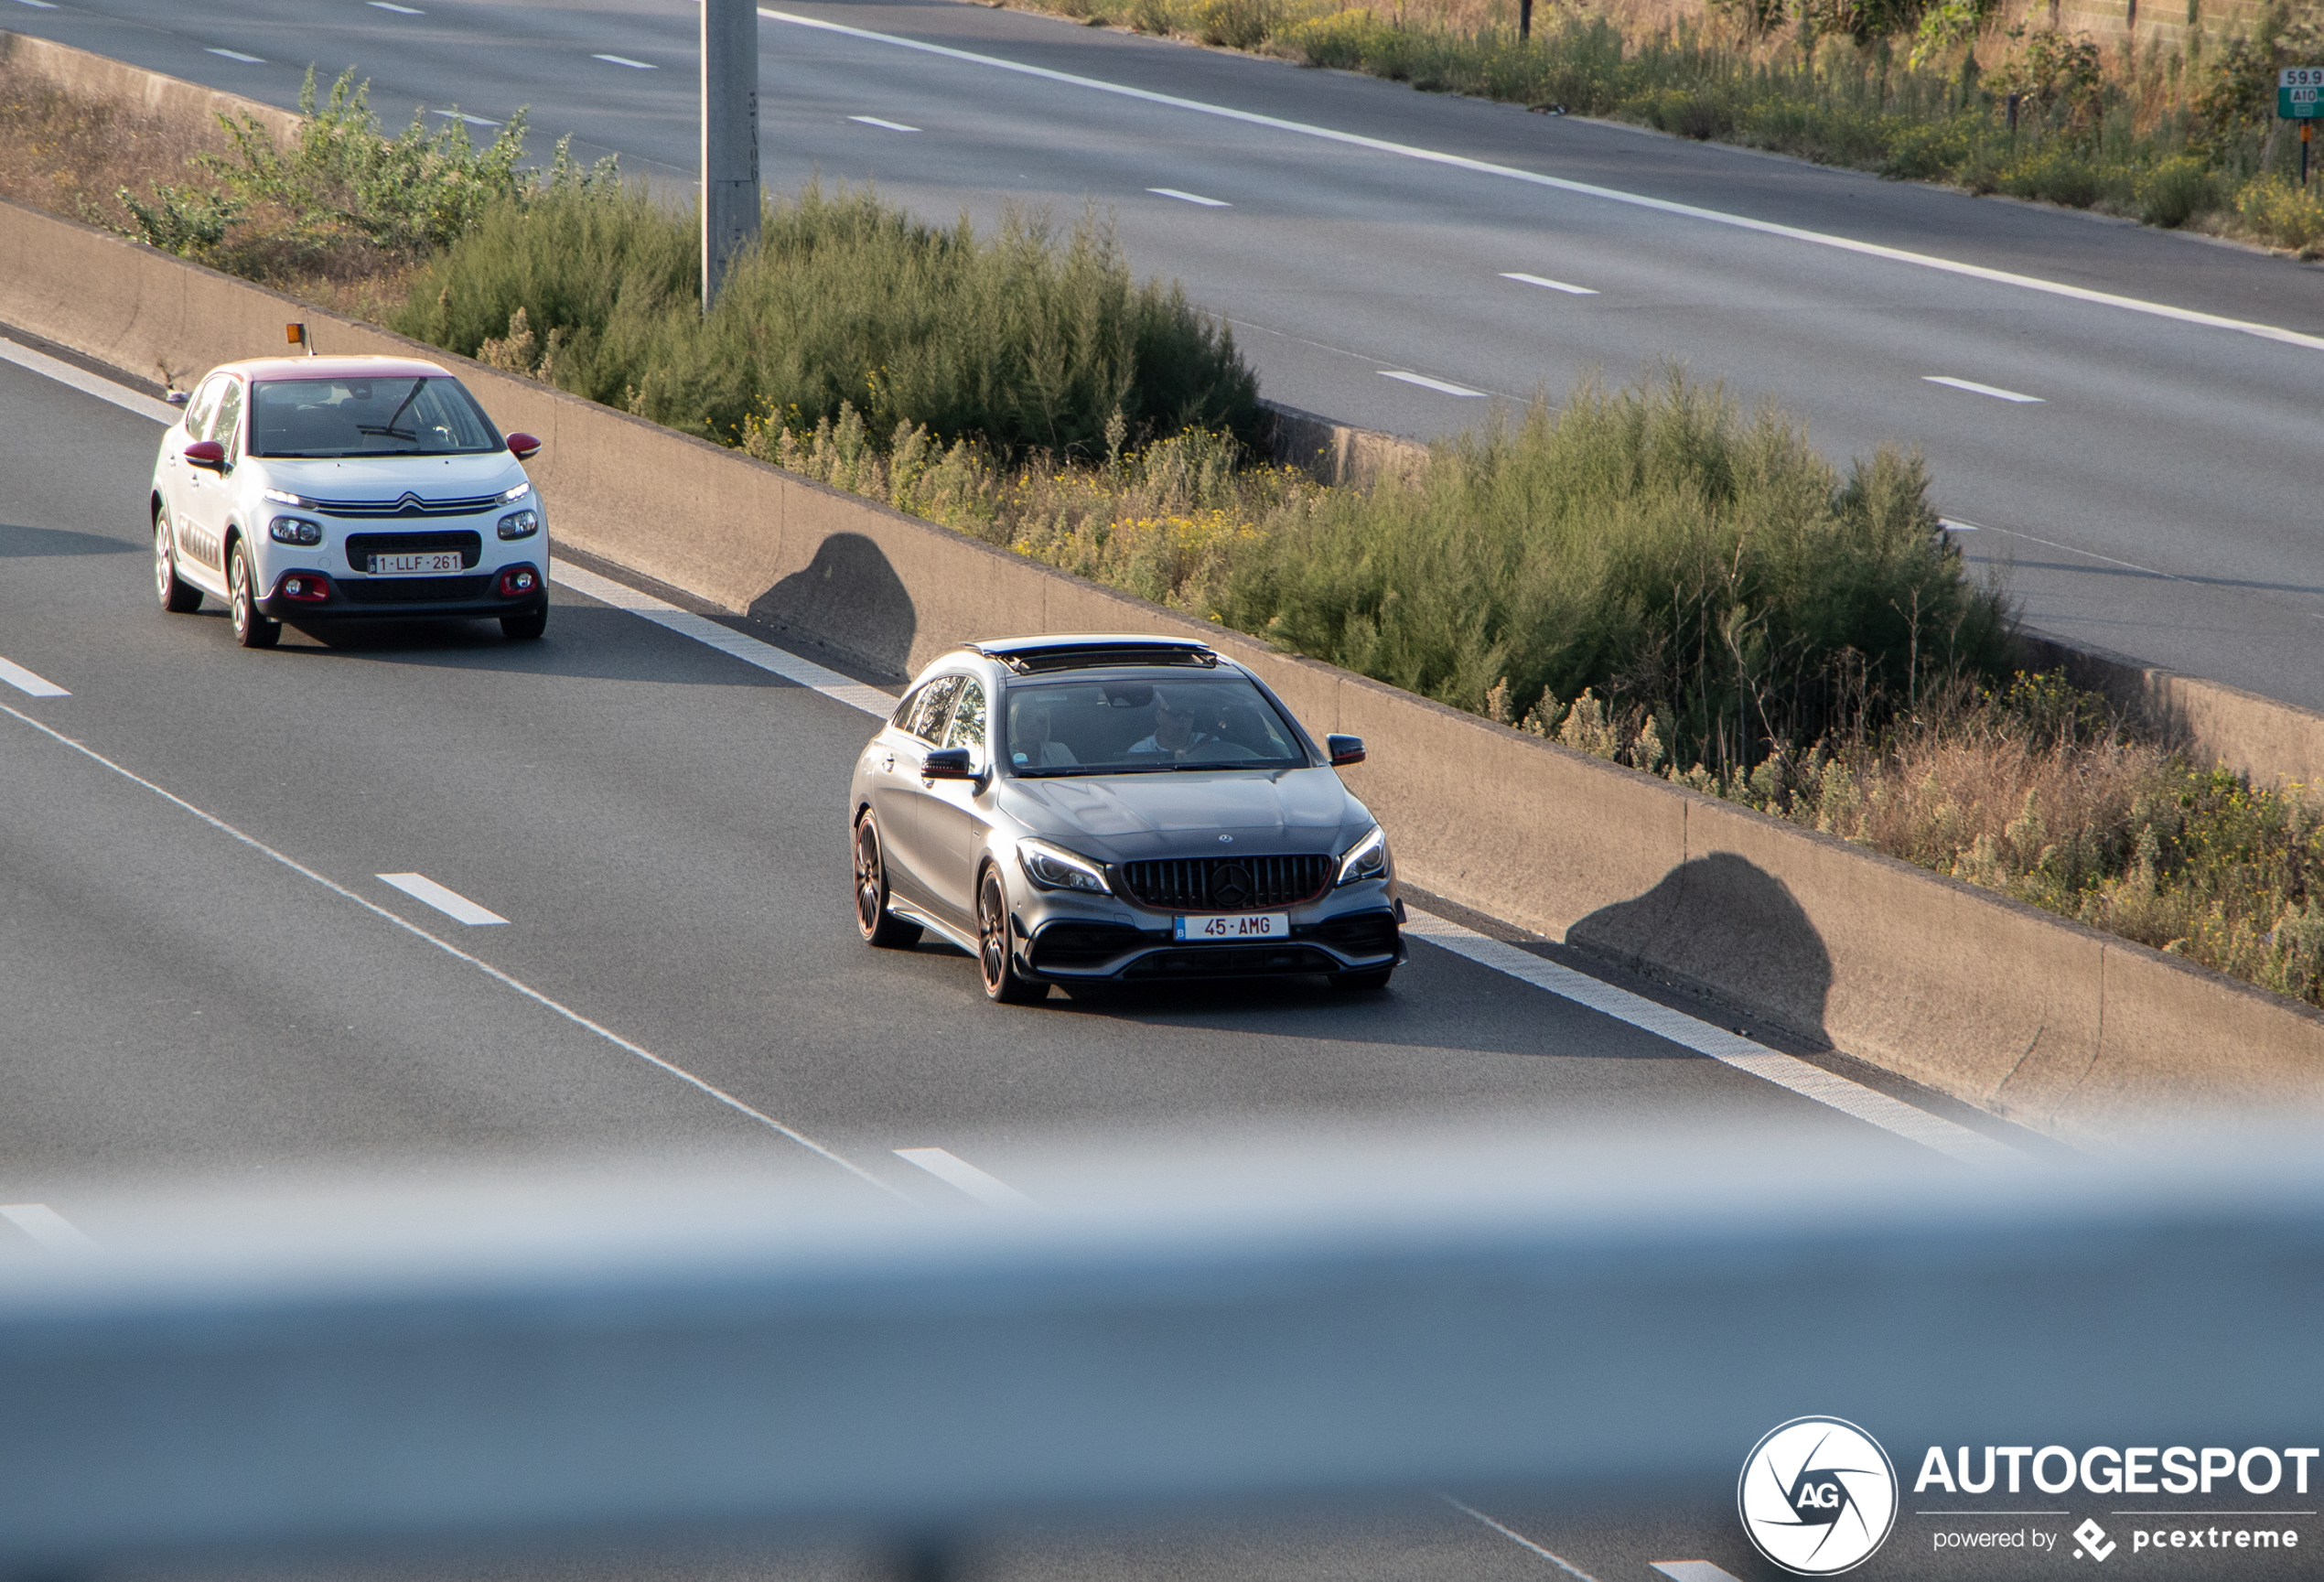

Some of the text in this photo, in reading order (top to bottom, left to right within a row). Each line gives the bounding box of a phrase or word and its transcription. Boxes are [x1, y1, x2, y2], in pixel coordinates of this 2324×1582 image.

[2287, 70, 2322, 85] 59.9
[2293, 90, 2316, 102] A10
[380, 554, 457, 571] 1-LLF-261
[1178, 917, 1270, 937] B 45-AMG
